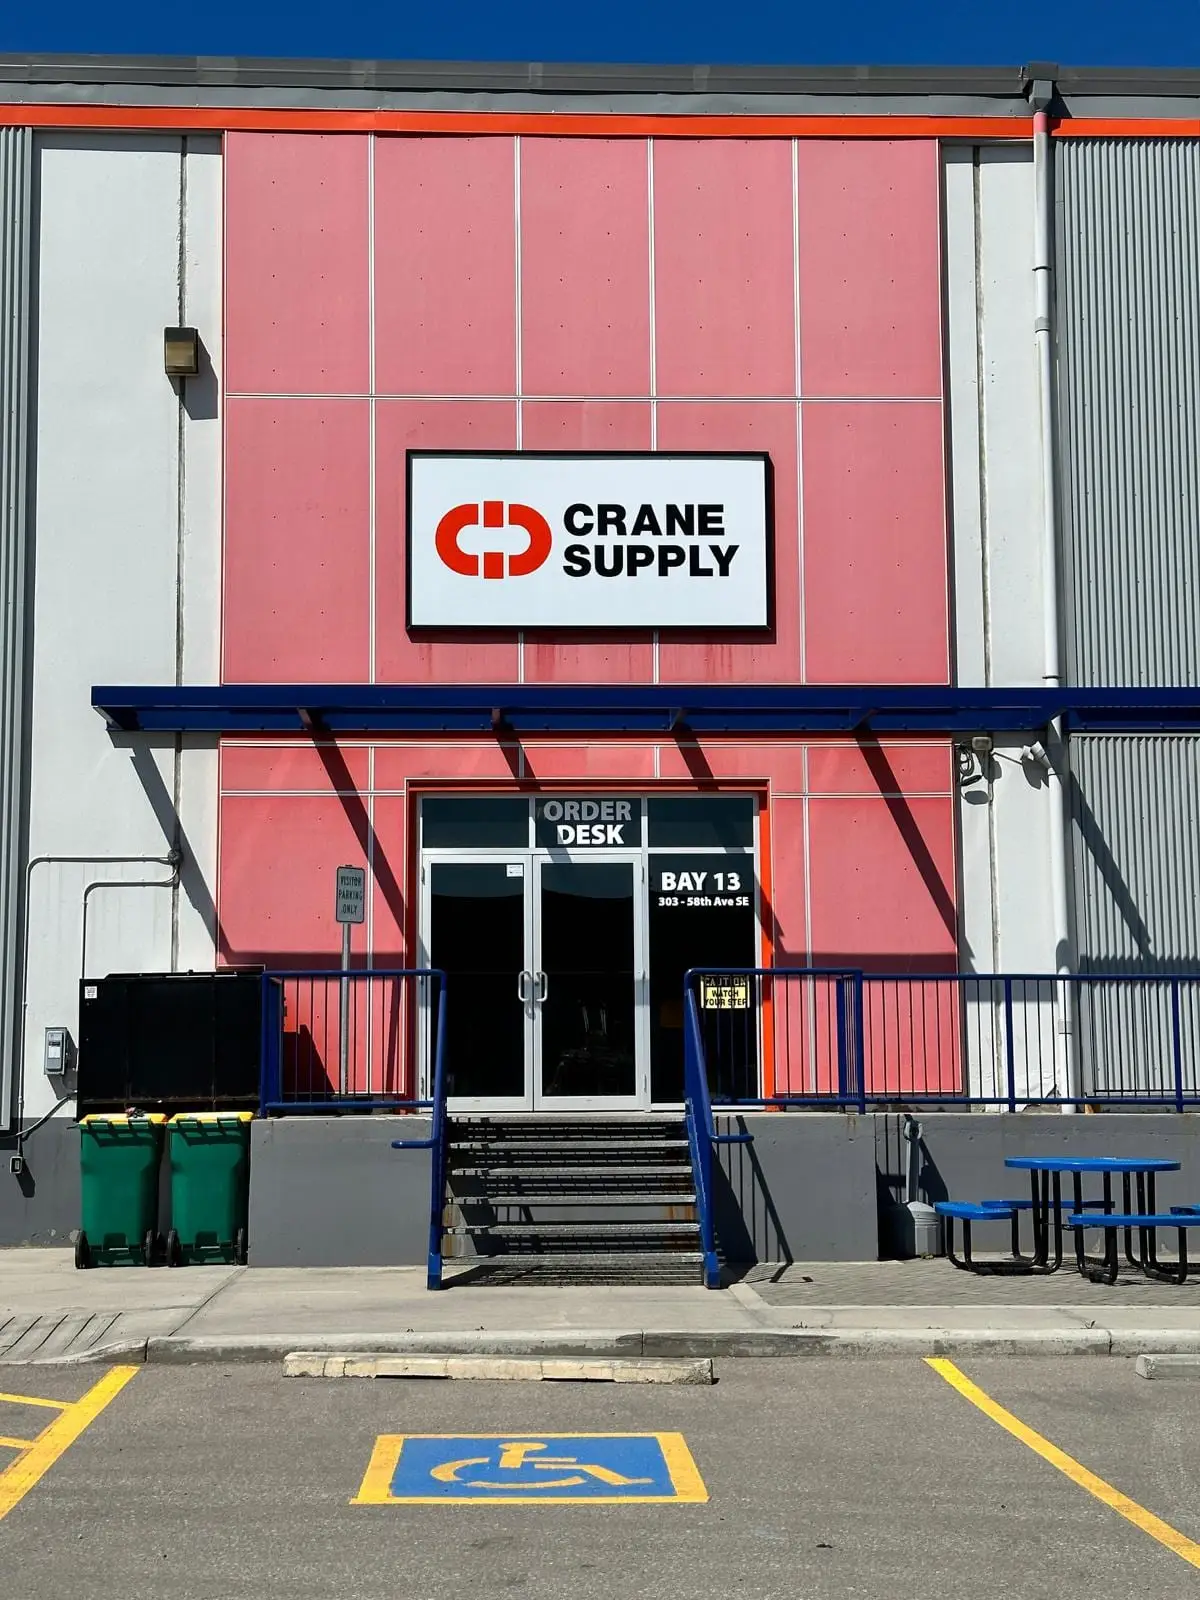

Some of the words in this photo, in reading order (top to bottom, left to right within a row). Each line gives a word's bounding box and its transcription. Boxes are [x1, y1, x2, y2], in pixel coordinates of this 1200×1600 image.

[563, 503, 725, 536] CRANE
[562, 544, 740, 577] SUPPLY
[543, 800, 632, 821] ORDER
[557, 824, 625, 845] DESK
[340, 876, 362, 886] VISITOR
[661, 872, 708, 891] BAY
[713, 872, 741, 891] 13
[658, 897, 679, 907] 303
[687, 896, 712, 907] 58th
[713, 896, 734, 907] Ave
[735, 896, 750, 907] SE
[342, 904, 358, 916] ONLY
[704, 977, 746, 986] CAUTON
[711, 989, 739, 997] WATCH
[704, 998, 726, 1006] YOUR
[727, 998, 747, 1006] STEP
